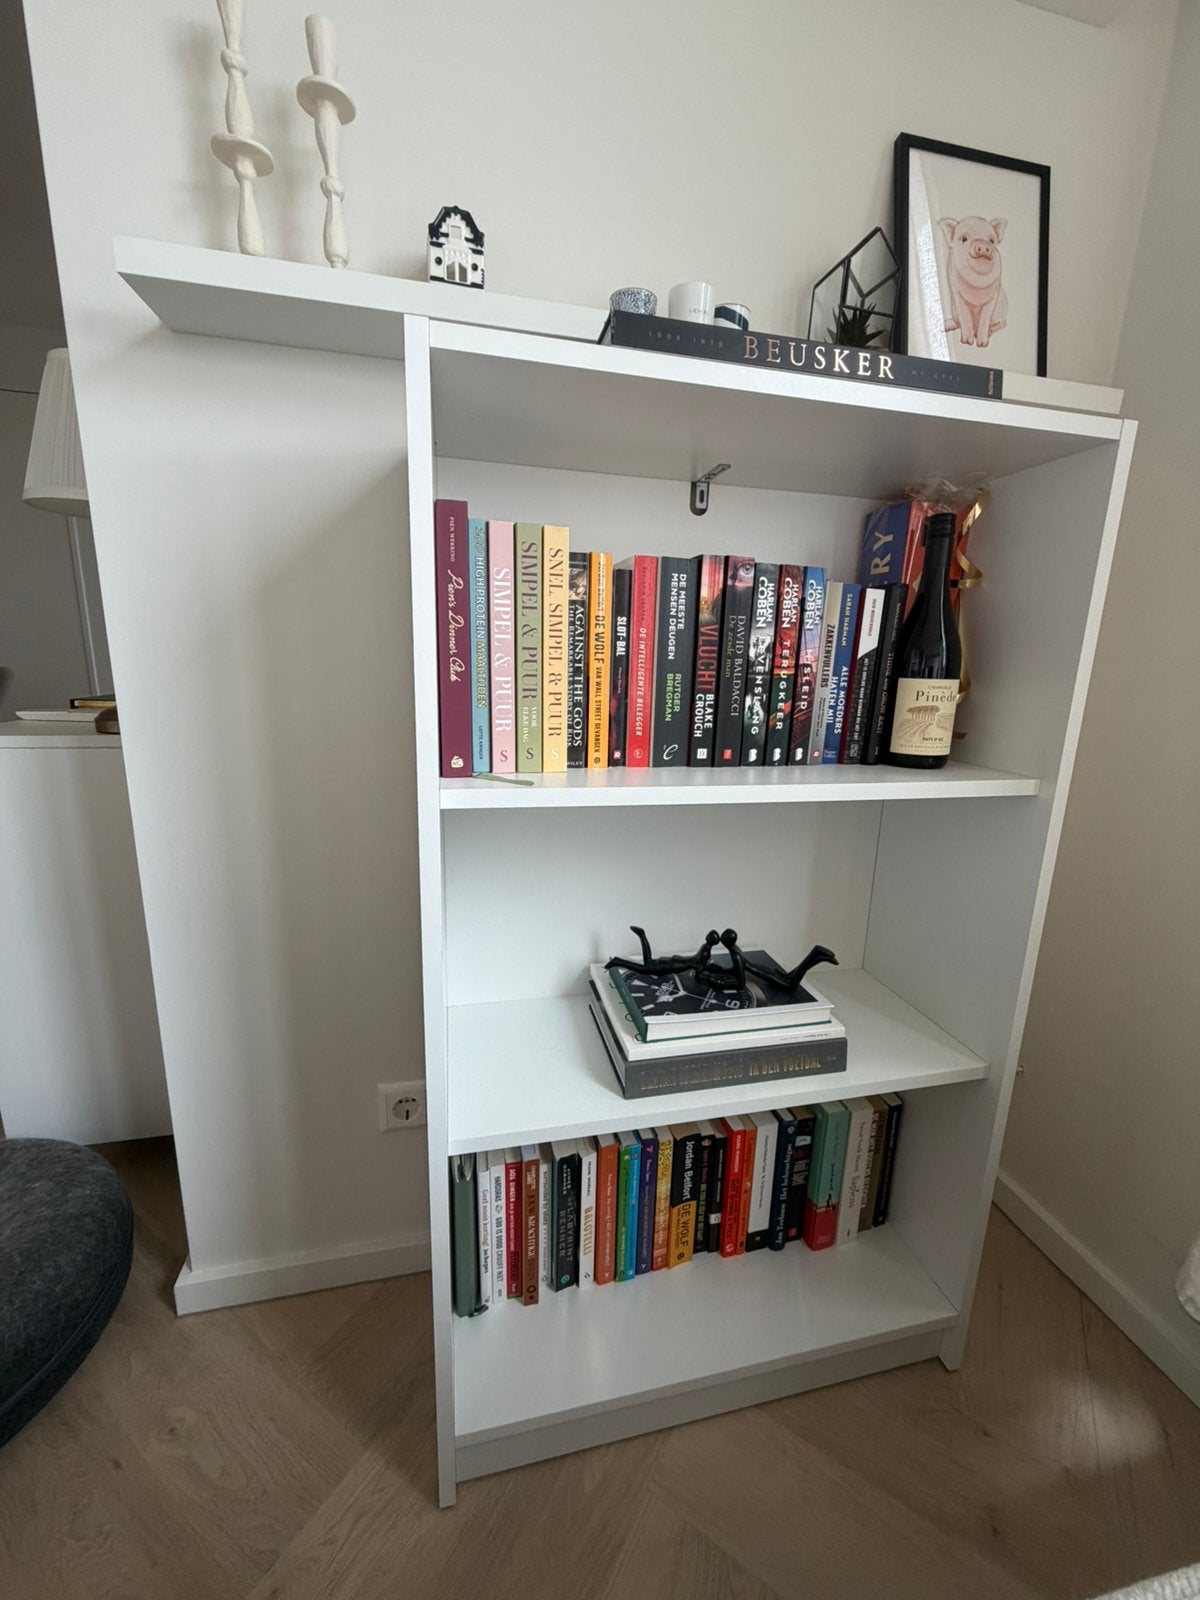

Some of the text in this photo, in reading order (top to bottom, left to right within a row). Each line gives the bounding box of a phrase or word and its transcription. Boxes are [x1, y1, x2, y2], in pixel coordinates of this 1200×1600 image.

[744, 335, 895, 379] BEUSKER
[475, 557, 484, 587] HIGH
[870, 531, 894, 580] RY
[679, 574, 686, 587] DE
[756, 577, 767, 627] COBEN
[766, 583, 775, 622] HARLAN
[782, 578, 793, 628] COBEN
[791, 584, 799, 623] HARLAN
[805, 580, 816, 629] COBEN
[814, 586, 822, 624] HARLAN
[447, 570, 465, 682] Pien's Dinner Club
[476, 590, 485, 638] PROTEIN
[521, 542, 537, 699] SIMPEL & PUUR
[616, 617, 626, 656] SLOT-BAL
[668, 573, 678, 659] MENSEN DEUGEN
[729, 615, 737, 627] De
[494, 567, 513, 731] SIMPEL & PUUR
[548, 548, 564, 737] SNEL, SIMPEL & PUUR
[594, 615, 605, 664] DE WOLF
[697, 625, 719, 691] VLUCHT
[726, 632, 735, 655] zesde
[820, 624, 835, 688] ZAKKENVULLERS
[476, 642, 486, 708] MAALTIJDEN
[573, 605, 583, 746] AGAINST THE GODS
[636, 628, 646, 736] DE INTELLIGENTE BELEGGER
[731, 616, 745, 716] DAVID BALDACCI
[752, 636, 767, 735] LEVENSLANG
[776, 640, 790, 730] TERUGKEER
[885, 653, 894, 676] THINK
[665, 674, 673, 721] BREGMAN
[694, 694, 704, 737] CROUCH
[704, 694, 714, 728] BLAKE
[827, 677, 838, 706] HATEN
[834, 666, 848, 734] ALLE MOEDERS
[879, 692, 888, 714] GROW
[876, 717, 886, 734] RICH
[682, 1141, 695, 1200] Jordan Belfort
[848, 1175, 859, 1208] Sapiens
[566, 1207, 574, 1262] LABYRINT
[583, 1206, 593, 1256] BALOTELLI
[679, 1204, 691, 1246] DE WOLF
